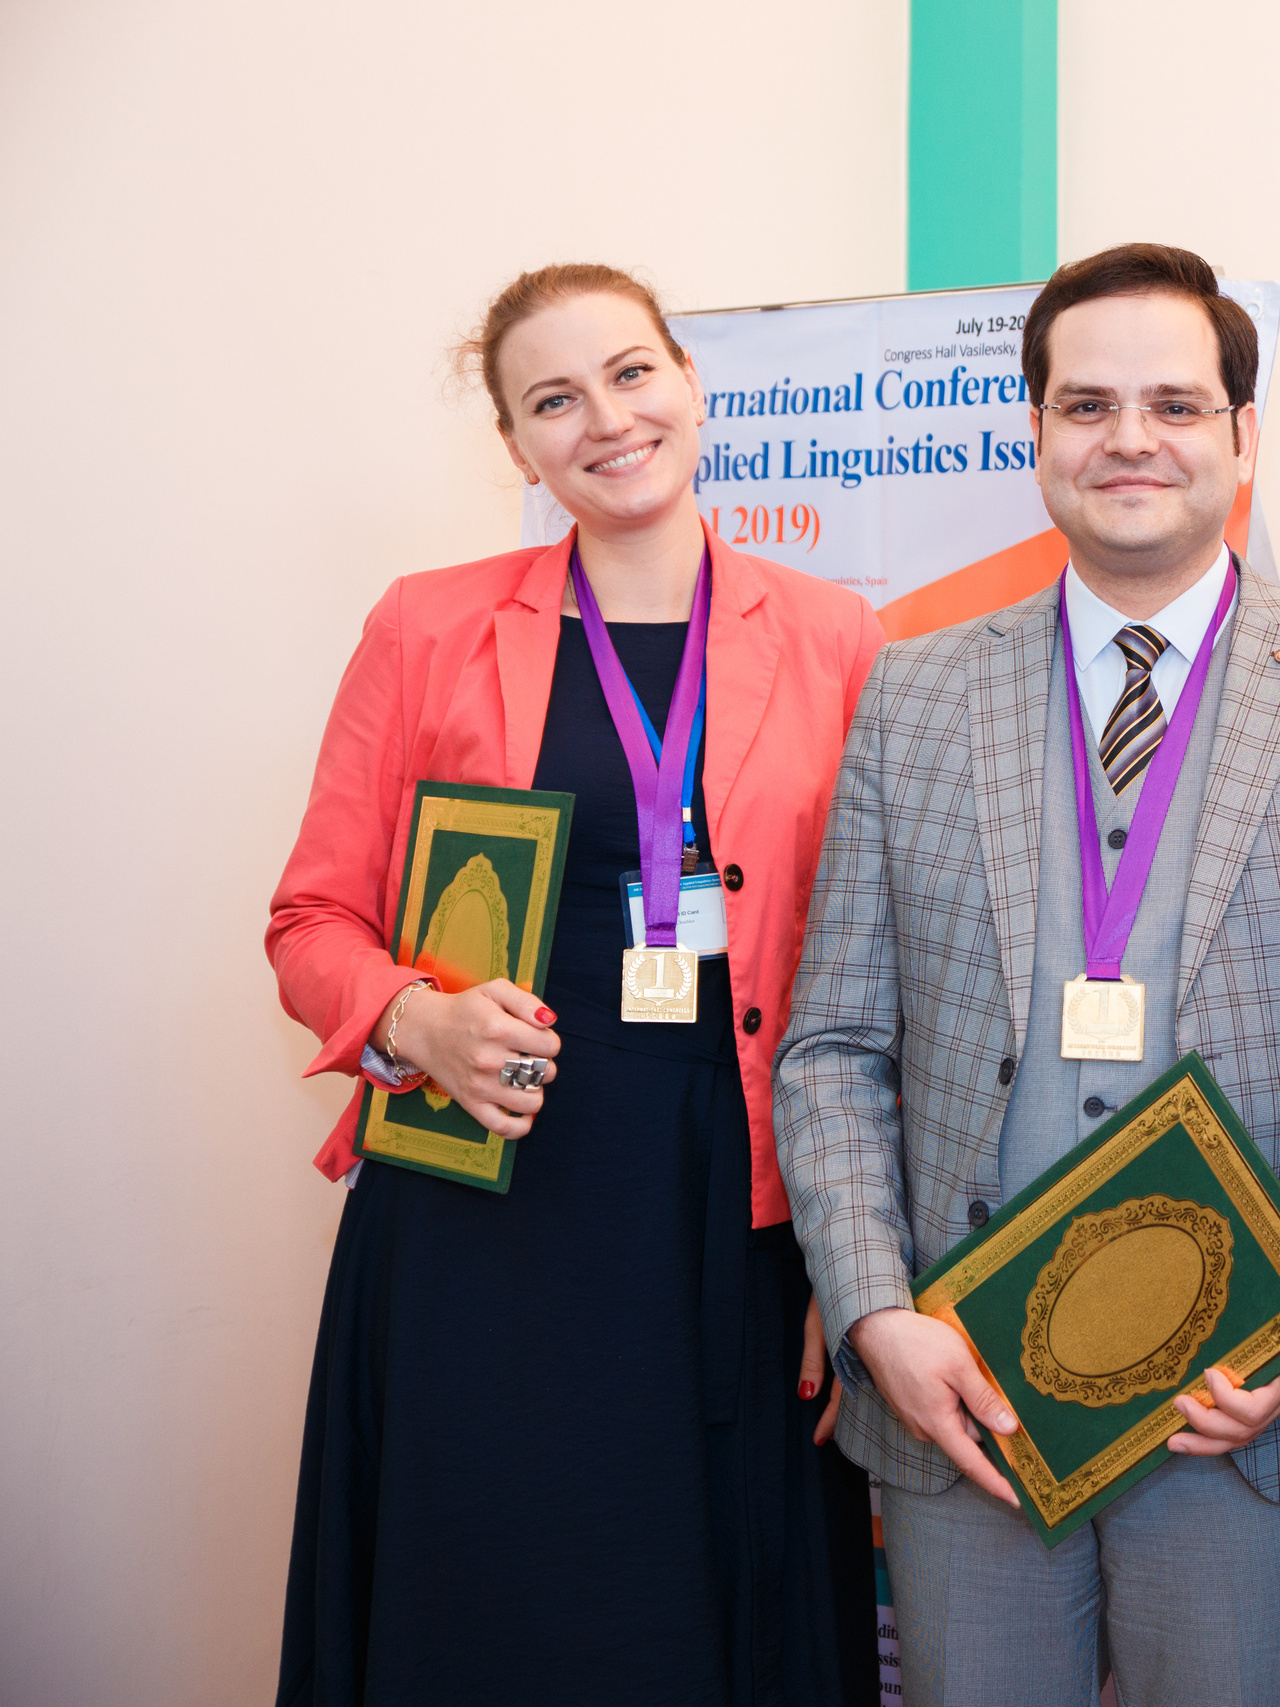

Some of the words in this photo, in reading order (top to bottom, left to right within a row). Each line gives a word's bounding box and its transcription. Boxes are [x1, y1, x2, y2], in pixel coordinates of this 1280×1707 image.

[956, 317, 984, 337] July
[884, 347, 933, 364] Congress
[935, 344, 957, 359] Hall
[959, 340, 1018, 358] Vasilevsky,
[703, 372, 864, 419] rnational
[779, 432, 968, 489] Linguistics
[731, 503, 821, 554] 2019)
